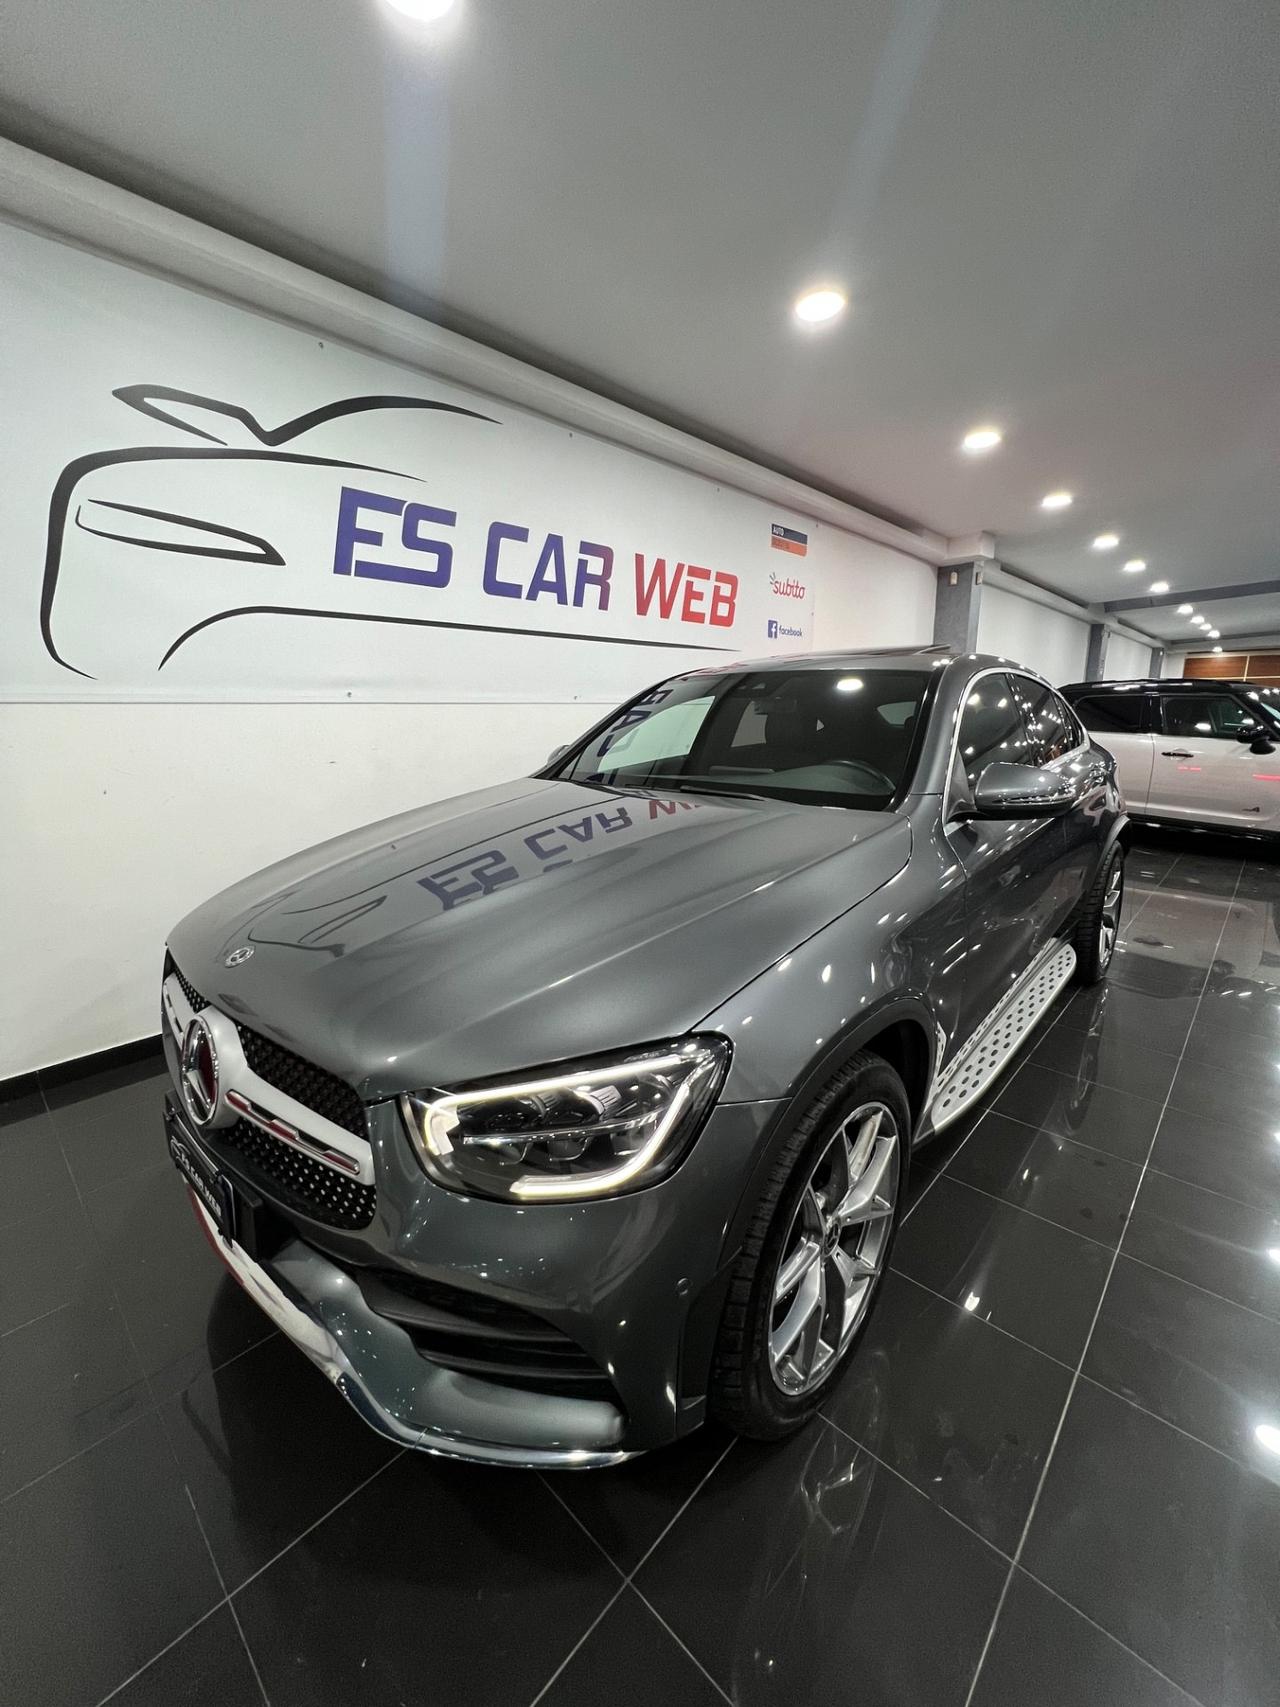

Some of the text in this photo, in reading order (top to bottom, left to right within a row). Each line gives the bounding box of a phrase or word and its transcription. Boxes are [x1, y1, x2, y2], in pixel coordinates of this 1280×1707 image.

[333, 486, 739, 628] ES CAR WEB
[773, 578, 806, 599] subito
[779, 625, 803, 637] facebook
